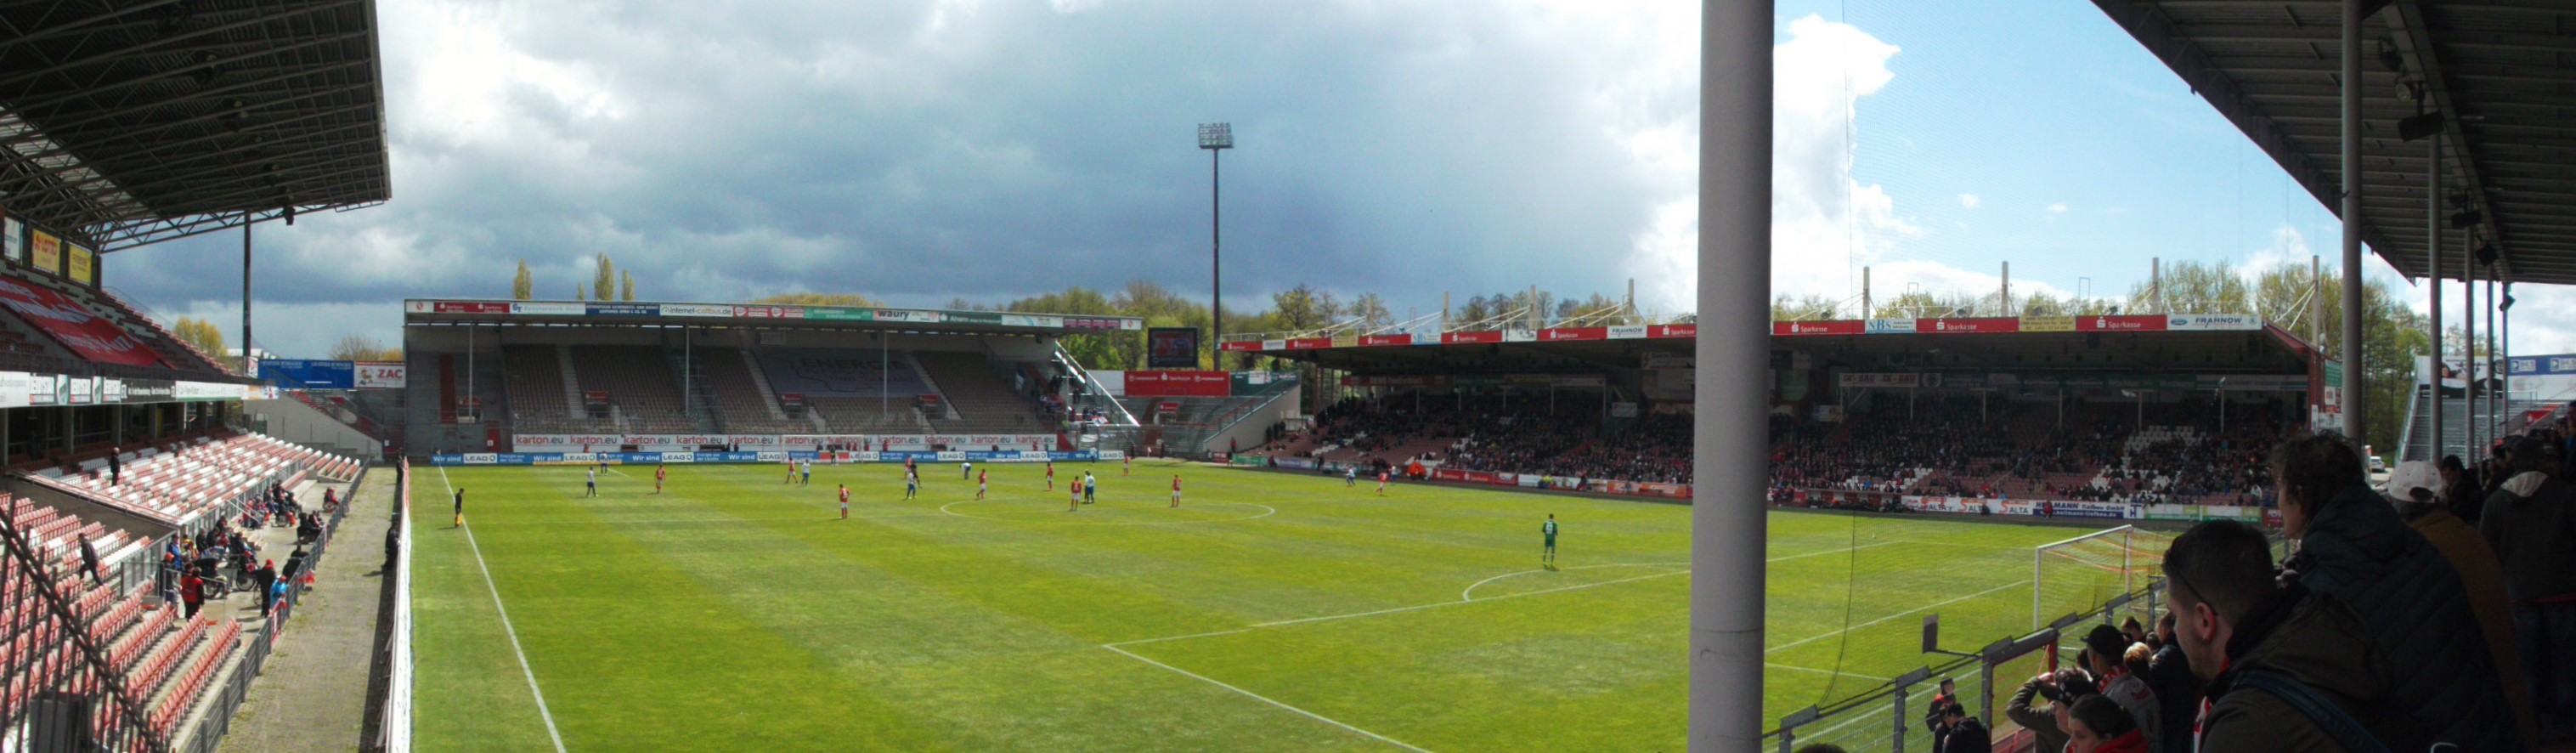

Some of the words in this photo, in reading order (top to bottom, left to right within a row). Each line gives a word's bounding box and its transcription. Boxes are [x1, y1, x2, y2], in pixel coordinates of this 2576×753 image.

[669, 307, 732, 315] internet-cottbus.de
[878, 311, 910, 321] waury
[2108, 321, 2141, 330] Sparkasse
[2195, 317, 2243, 328] FRAHNOW
[1613, 327, 1643, 337] FRAHNOW
[377, 369, 404, 379] ZAC
[517, 435, 564, 444] karton.eu
[570, 435, 617, 444] karton.eu
[624, 435, 669, 444] karton.eu
[676, 435, 722, 444] karton.eu
[728, 435, 773, 444] karton.eu
[878, 435, 919, 444] karton.eu
[924, 435, 965, 444] karton.eu
[971, 435, 1011, 444] karton.eu
[1015, 435, 1054, 444] karton.eu
